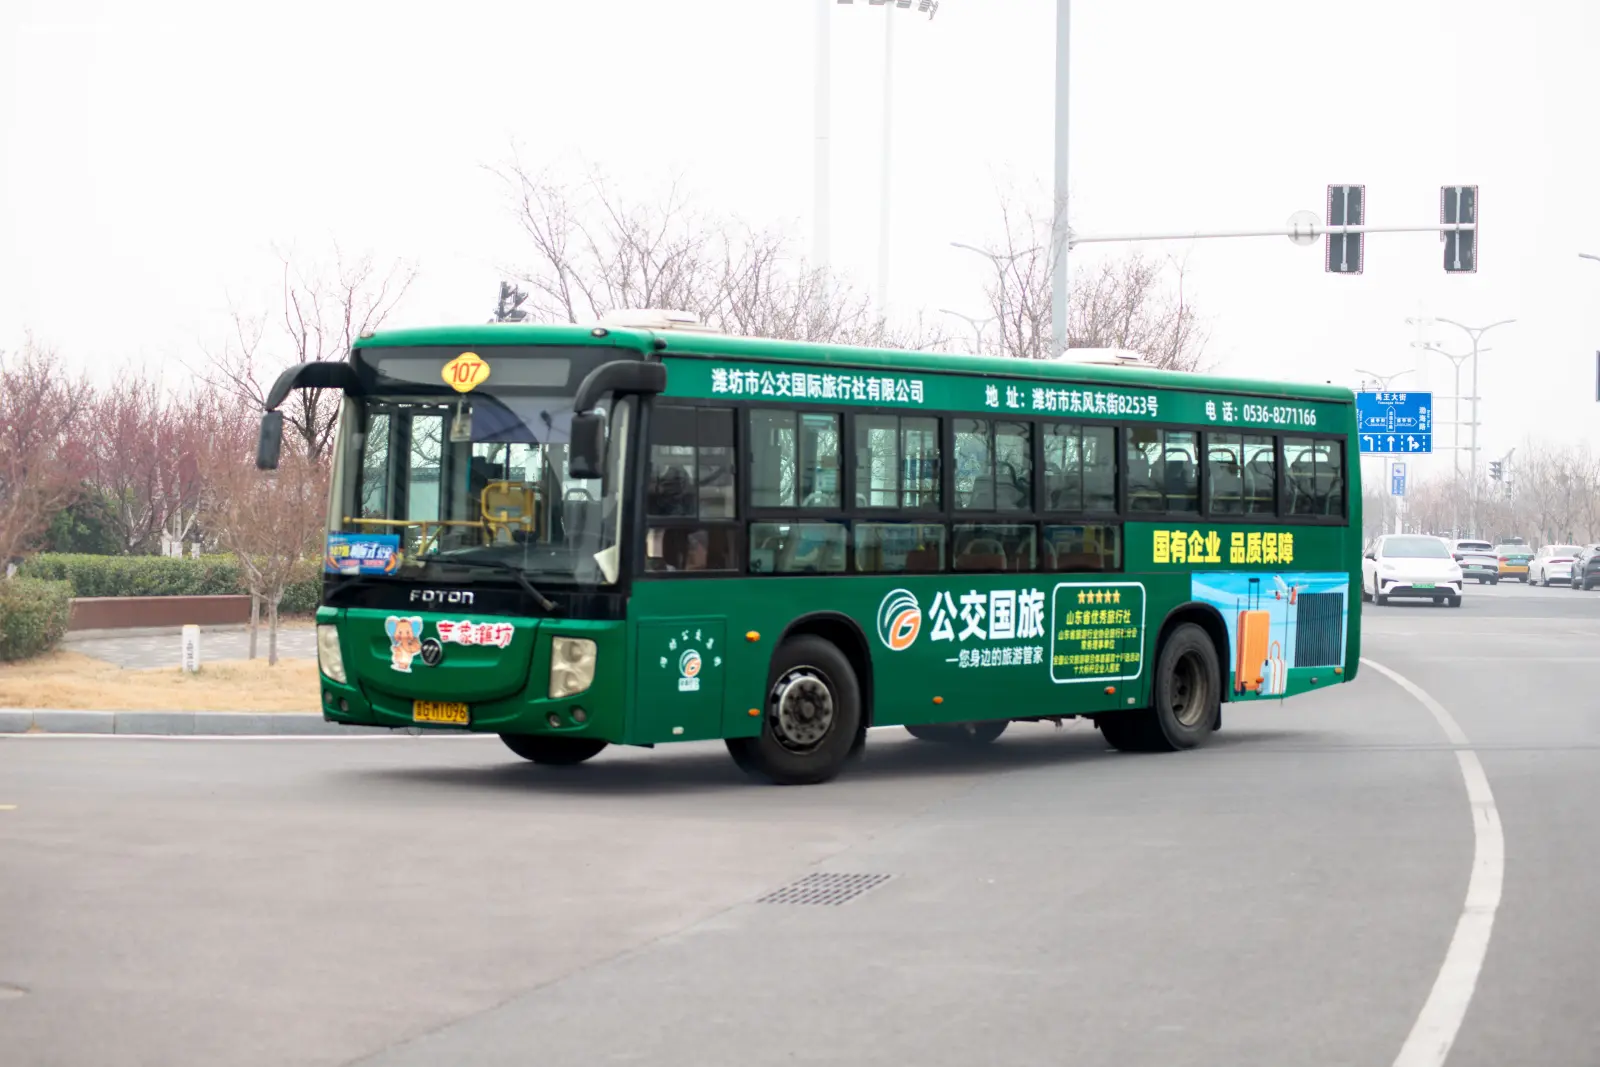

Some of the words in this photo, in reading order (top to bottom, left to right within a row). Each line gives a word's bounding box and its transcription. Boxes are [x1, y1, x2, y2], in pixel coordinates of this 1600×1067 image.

[451, 362, 481, 383] 107
[711, 368, 924, 404] 潍坊市公交国际旅行社有限公司
[1153, 530, 1221, 564] 国有企业
[1230, 532, 1294, 564] 品质保障
[410, 590, 474, 604] FOTON
[928, 588, 1045, 642] 公交国旅
